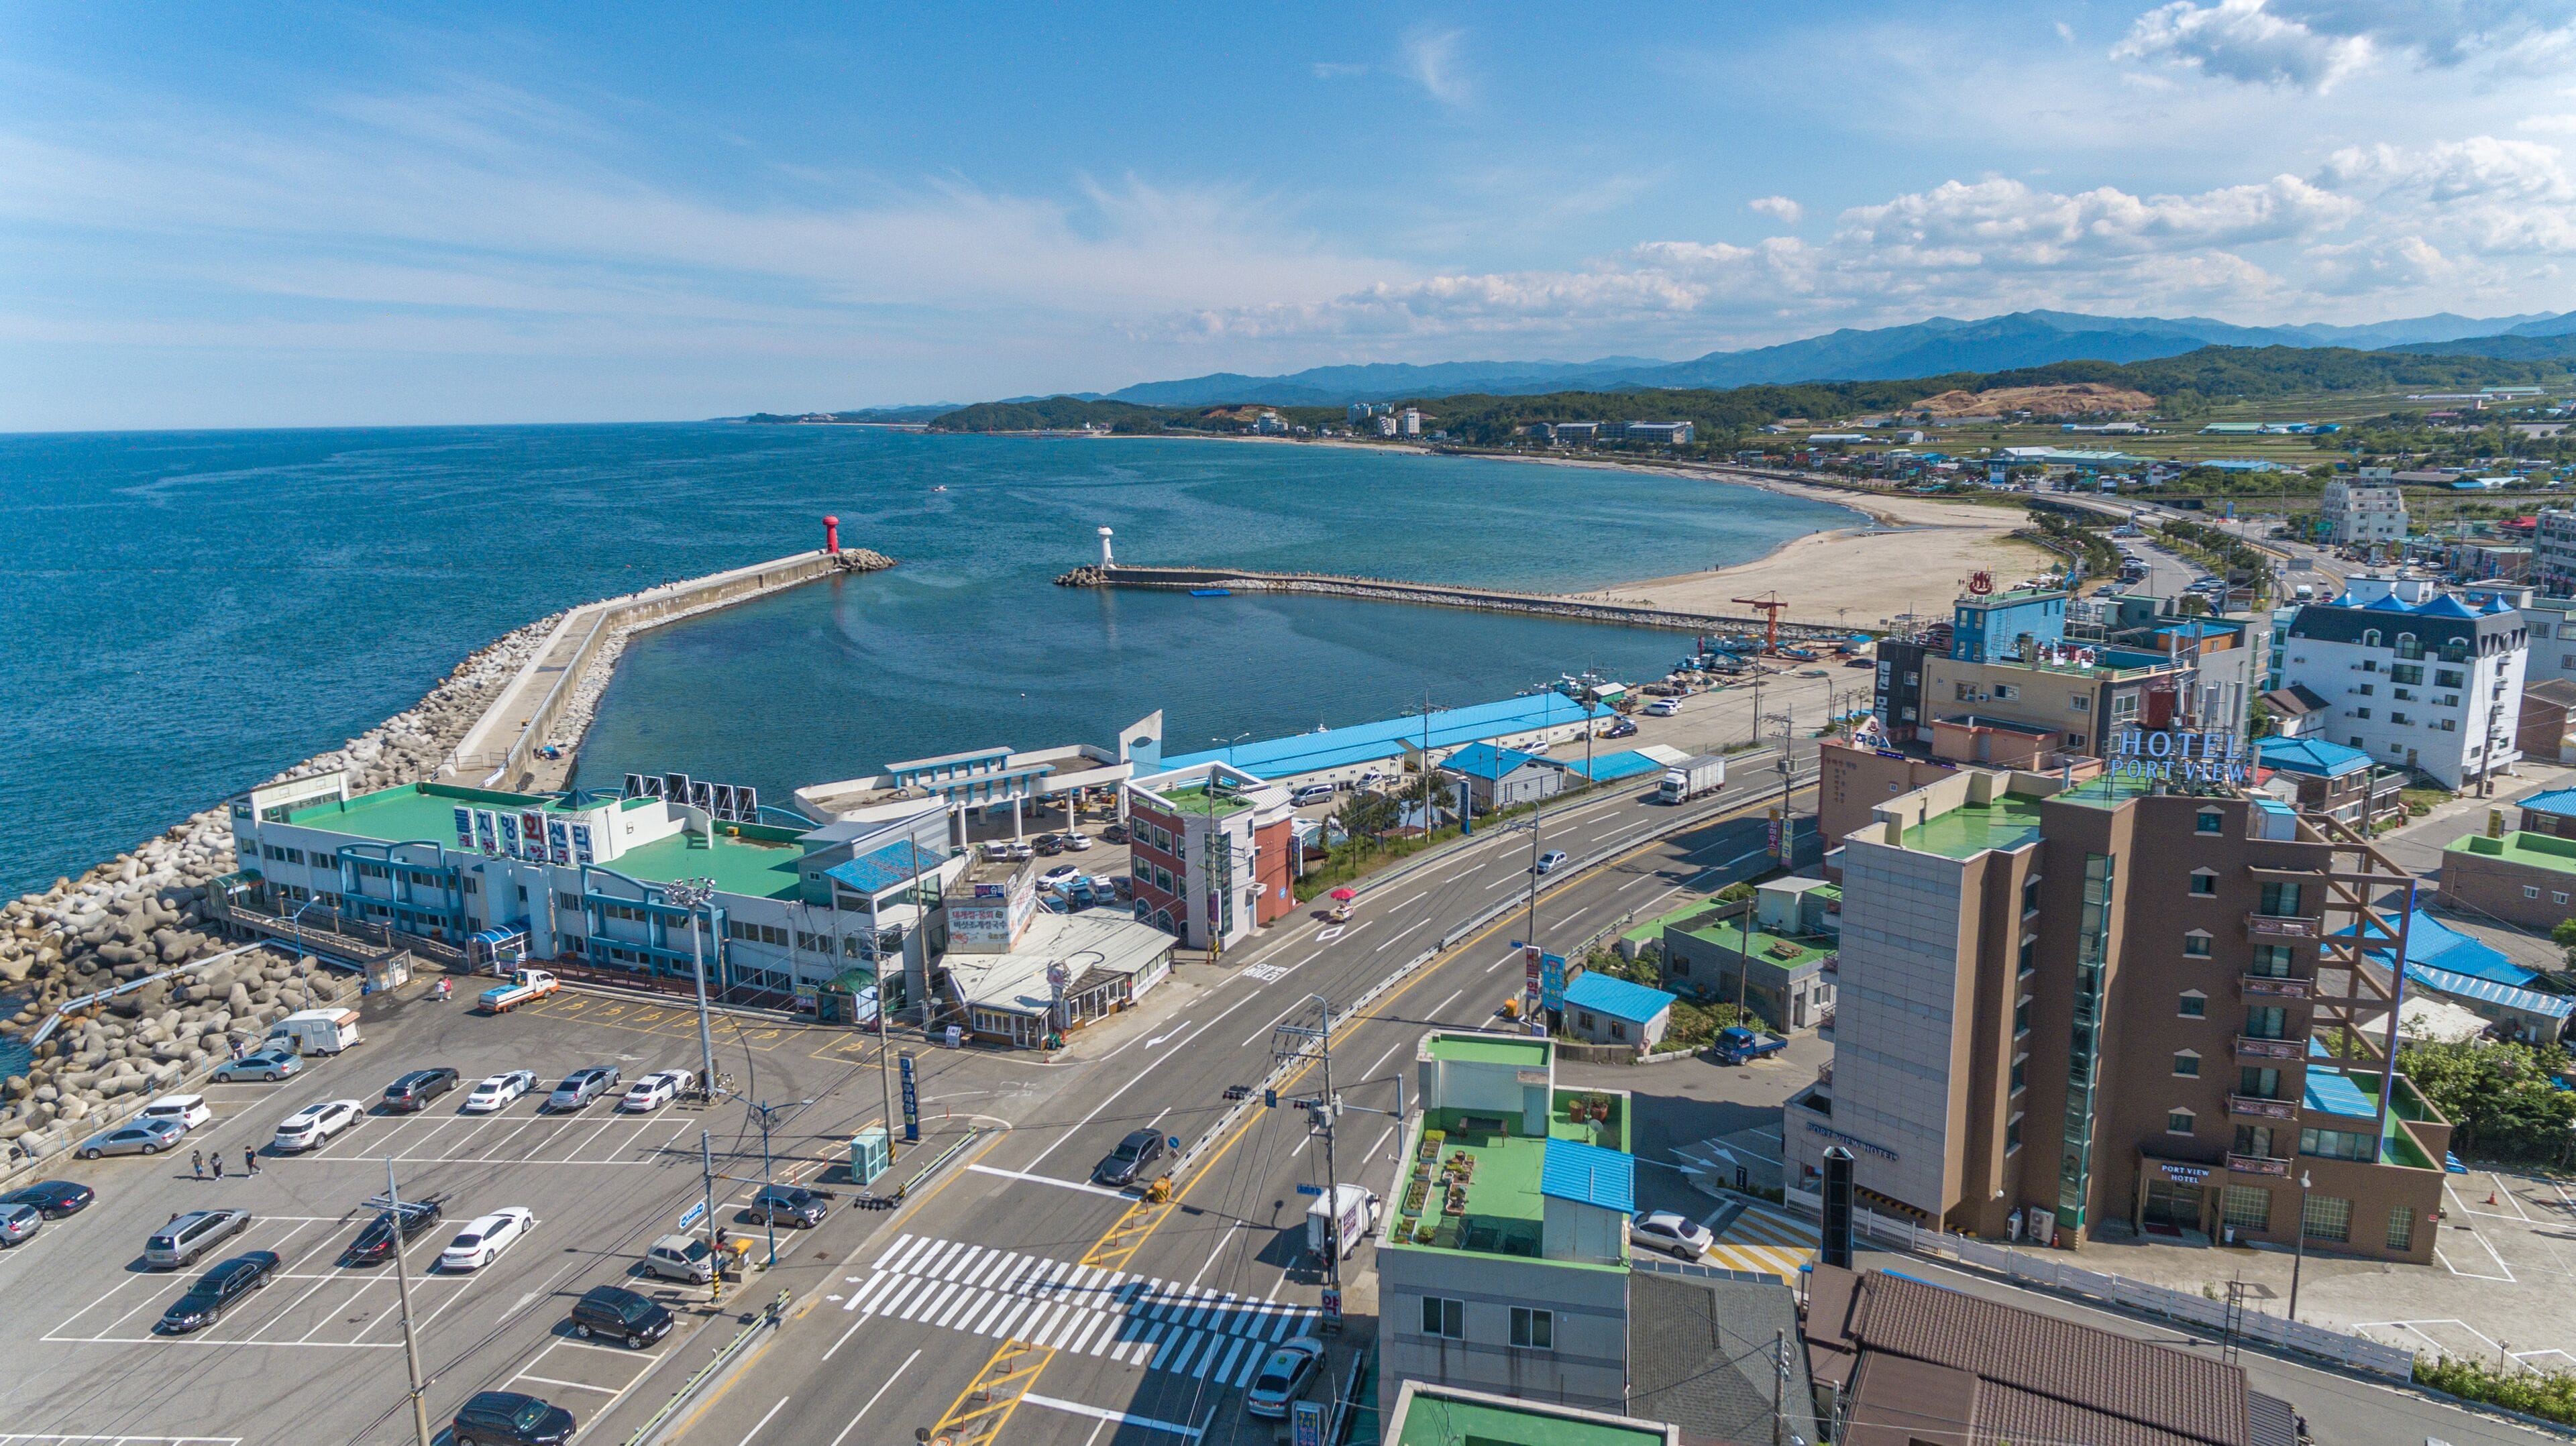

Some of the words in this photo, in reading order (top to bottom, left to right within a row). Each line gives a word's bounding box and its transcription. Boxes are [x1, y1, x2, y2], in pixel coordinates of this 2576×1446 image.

[2120, 730, 2241, 759] HOTEL
[2110, 759, 2176, 780] PORT
[2184, 762, 2247, 783] VIEW
[1527, 981, 1538, 995] 약
[1807, 1121, 1833, 1138] PORT
[1835, 1133, 1861, 1148] VIEW
[1863, 1142, 1897, 1162] HOTEL
[2161, 1164, 2185, 1174] PORT
[2187, 1168, 2210, 1176] VIEW
[2171, 1174, 2199, 1184] HOTEL
[1322, 1295, 1339, 1317] 약
